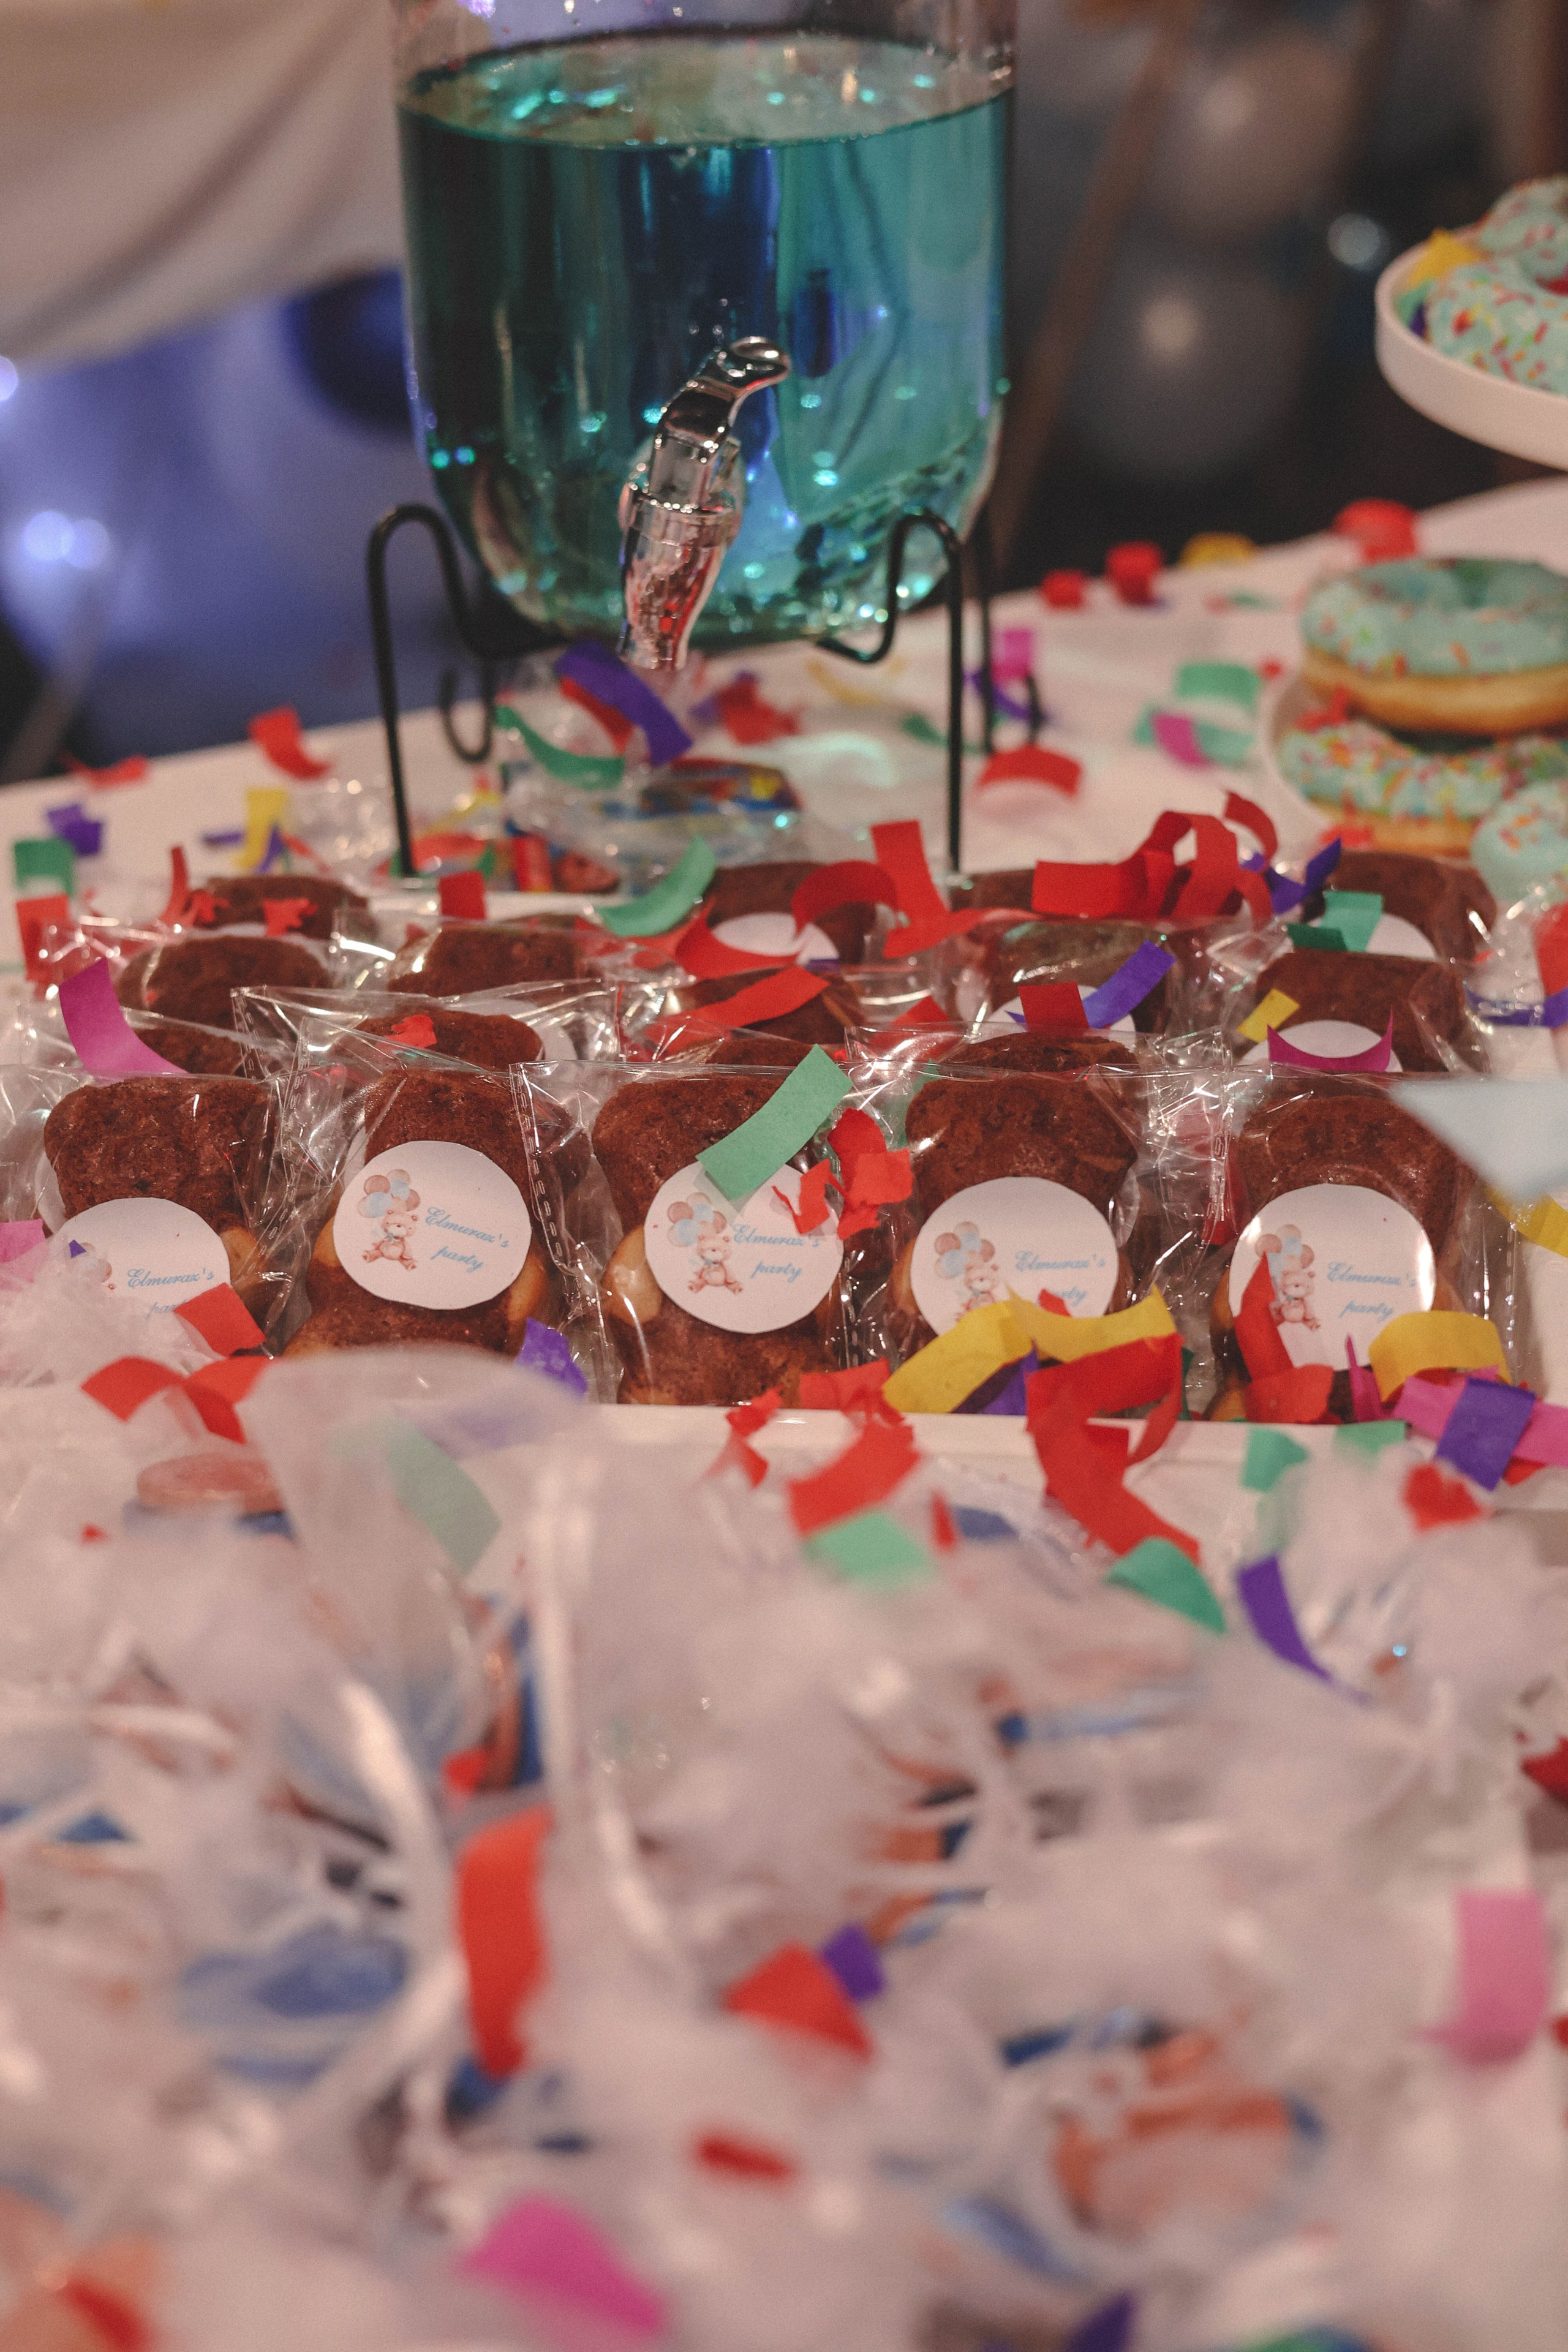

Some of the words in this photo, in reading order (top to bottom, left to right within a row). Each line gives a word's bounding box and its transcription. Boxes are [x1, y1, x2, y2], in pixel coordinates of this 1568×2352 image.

[431, 1246, 484, 1273] party
[750, 1261, 802, 1283] party
[1338, 1300, 1394, 1322] party
